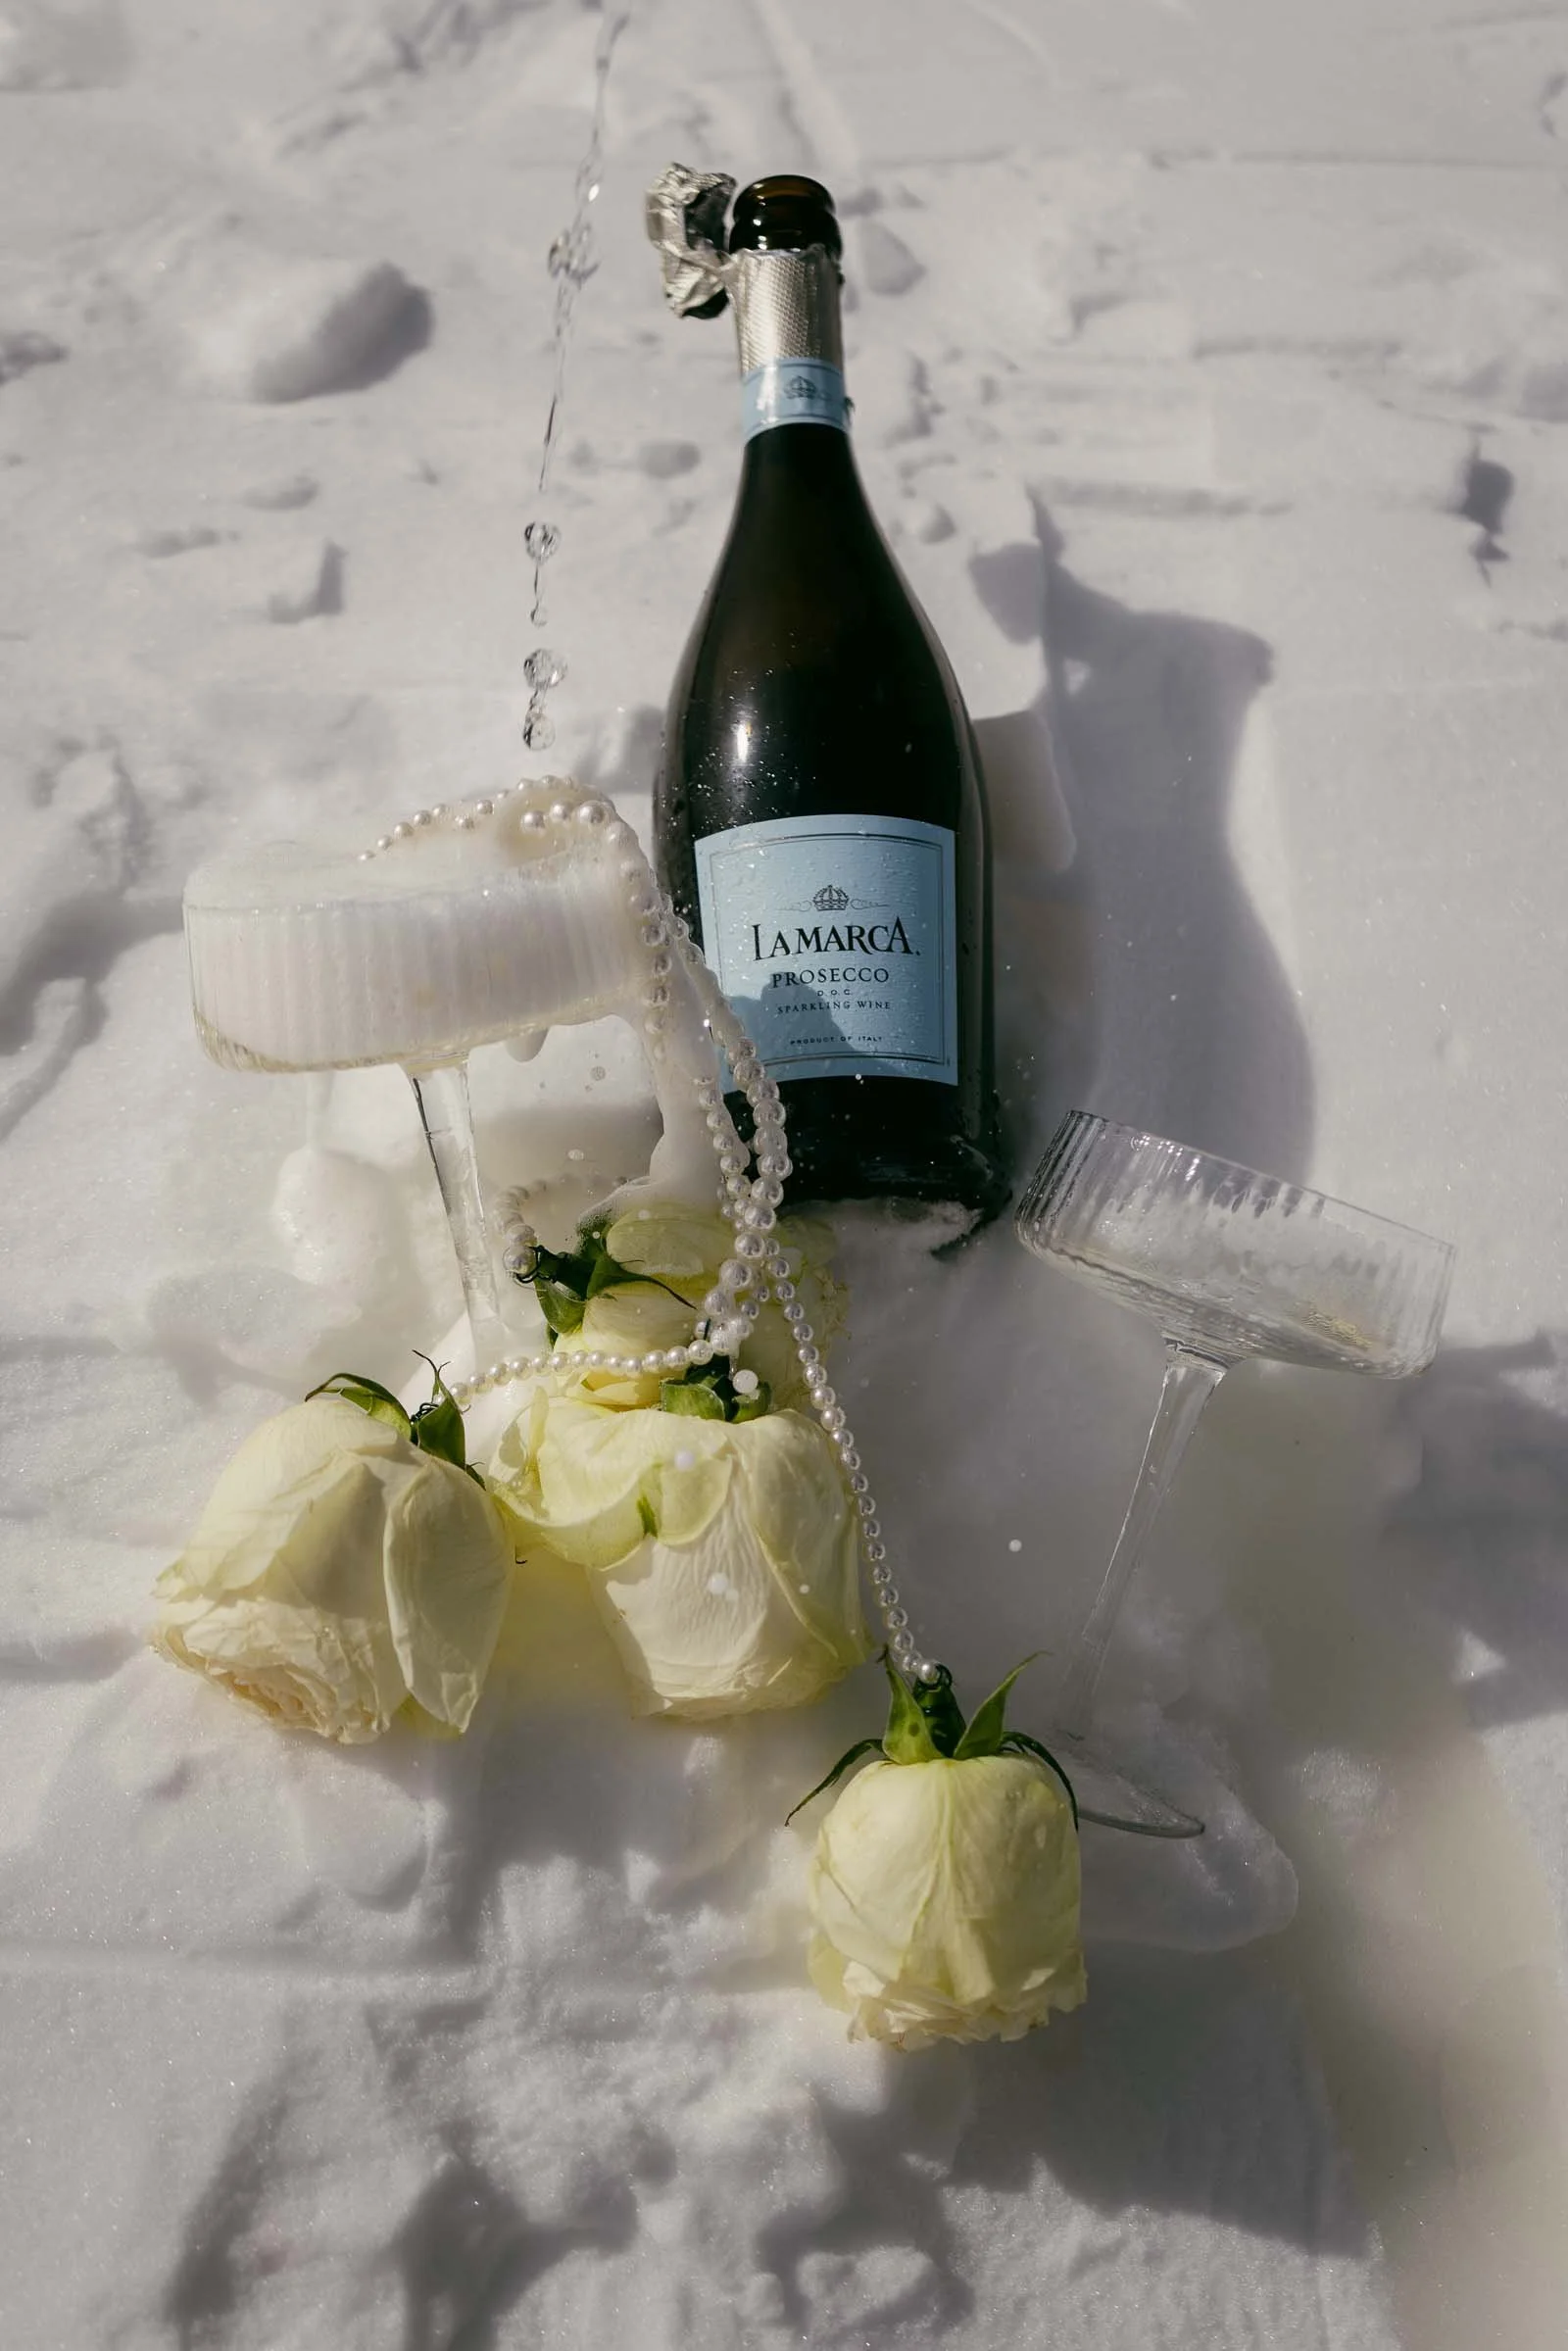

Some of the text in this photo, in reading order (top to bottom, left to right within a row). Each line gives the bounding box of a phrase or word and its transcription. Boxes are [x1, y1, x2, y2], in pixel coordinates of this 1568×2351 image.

[771, 967, 890, 989] PROSECCO
[777, 1001, 891, 1014] SPARKLING WINE
[790, 1036, 835, 1046] PRODUCT
